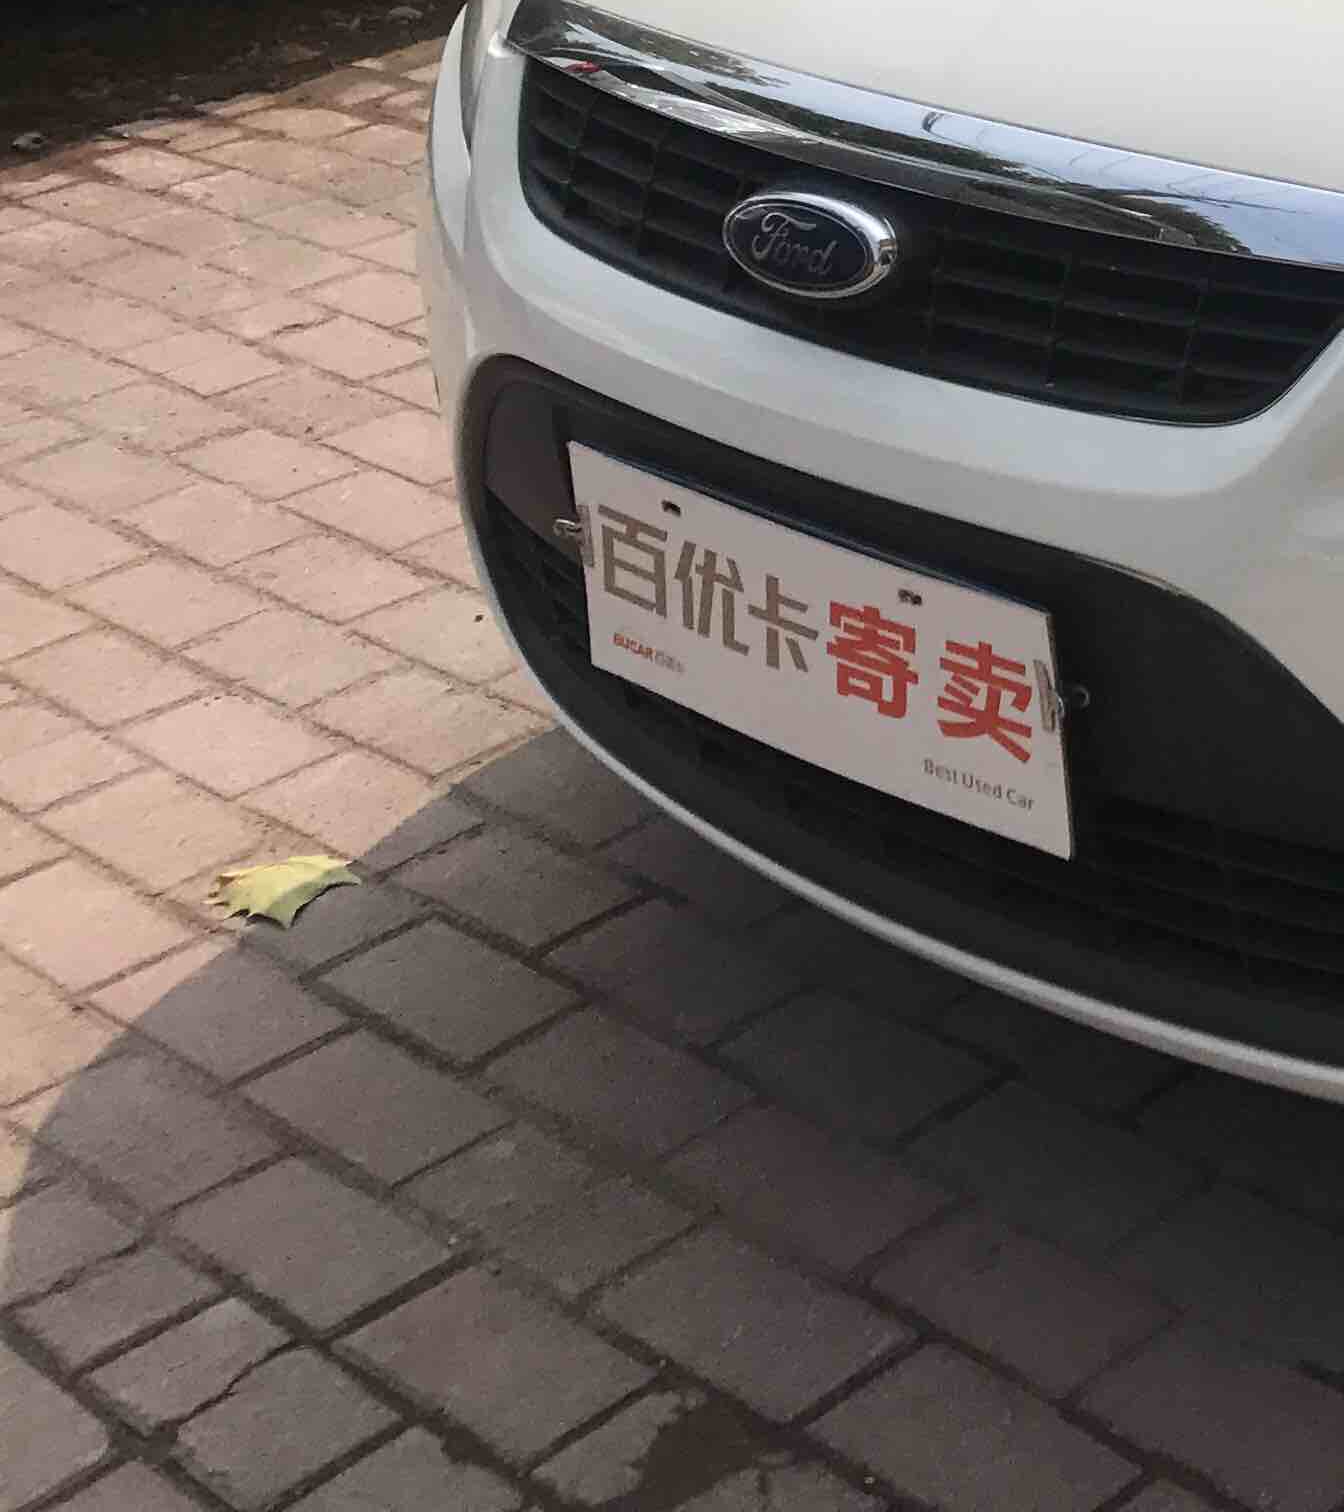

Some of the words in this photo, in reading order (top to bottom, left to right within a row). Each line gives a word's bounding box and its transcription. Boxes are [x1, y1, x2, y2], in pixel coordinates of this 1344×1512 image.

[751, 211, 838, 276] Ford
[597, 503, 1034, 763] 百优卡寄卖
[923, 758, 957, 784] Best
[961, 772, 1003, 800] Used
[1006, 788, 1034, 811] Car
